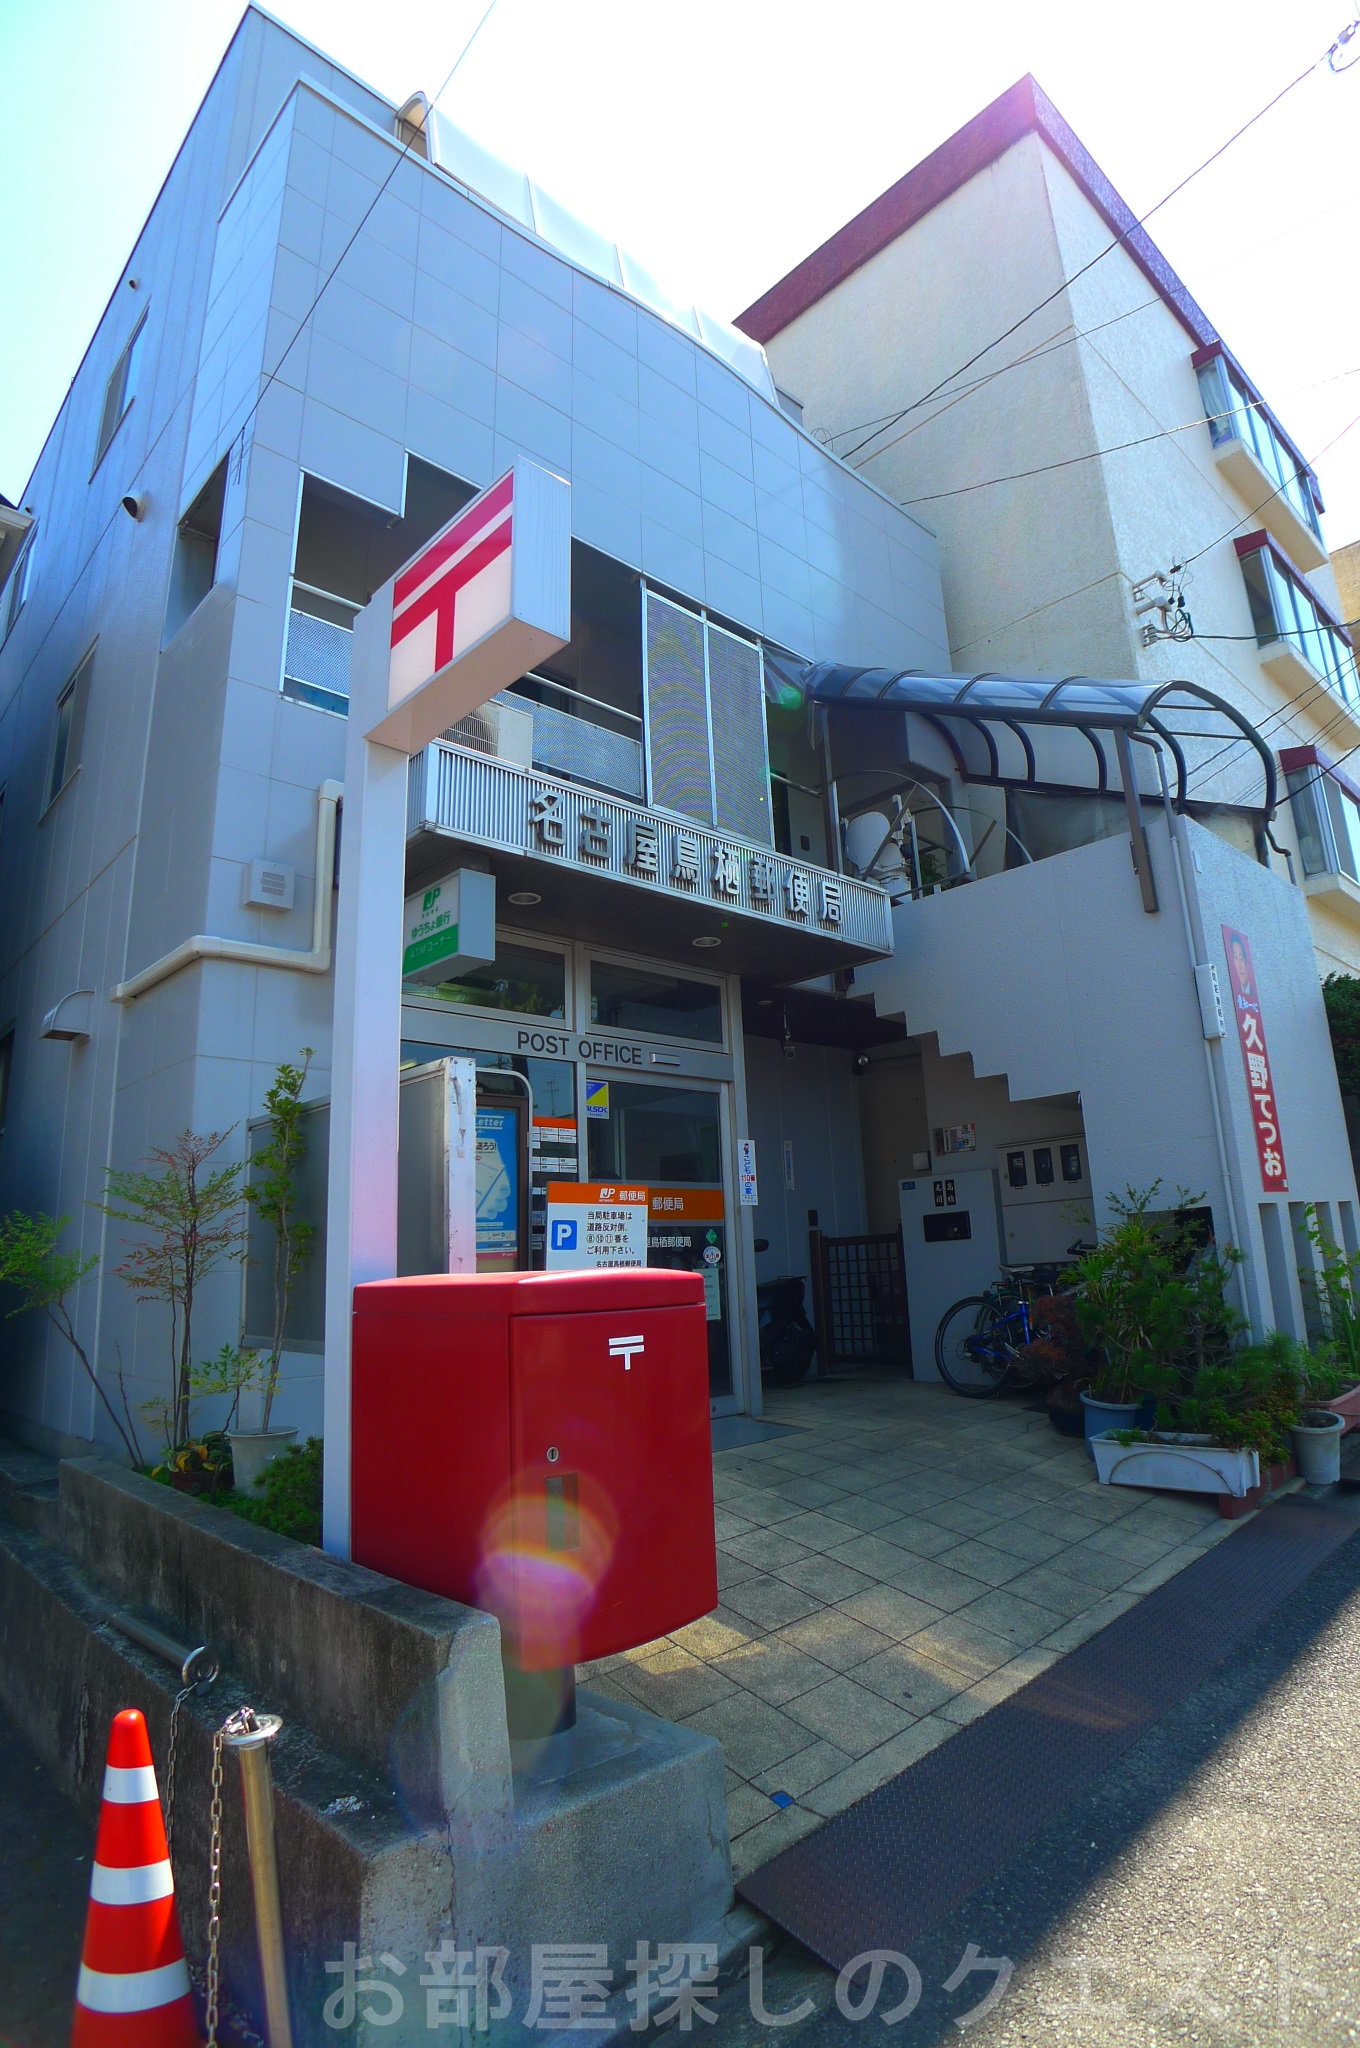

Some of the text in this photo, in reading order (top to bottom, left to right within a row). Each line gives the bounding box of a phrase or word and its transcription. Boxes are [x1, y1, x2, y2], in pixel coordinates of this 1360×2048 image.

[529, 789, 843, 925] 名古屋鳥栖郵便局
[411, 910, 450, 939] ゆうちょ銀行
[517, 1031, 642, 1065] POST OFFICE
[1242, 1014, 1282, 1176] 久野てつお
[619, 1190, 646, 1202] 郵便局
[652, 1197, 684, 1211] 郵便局
[587, 1211, 633, 1221] 当局駐車場は
[556, 1224, 572, 1247] P
[586, 1245, 636, 1255] ご利用下さい。
[595, 1260, 642, 1268] 名古屋鳥栖郵便局
